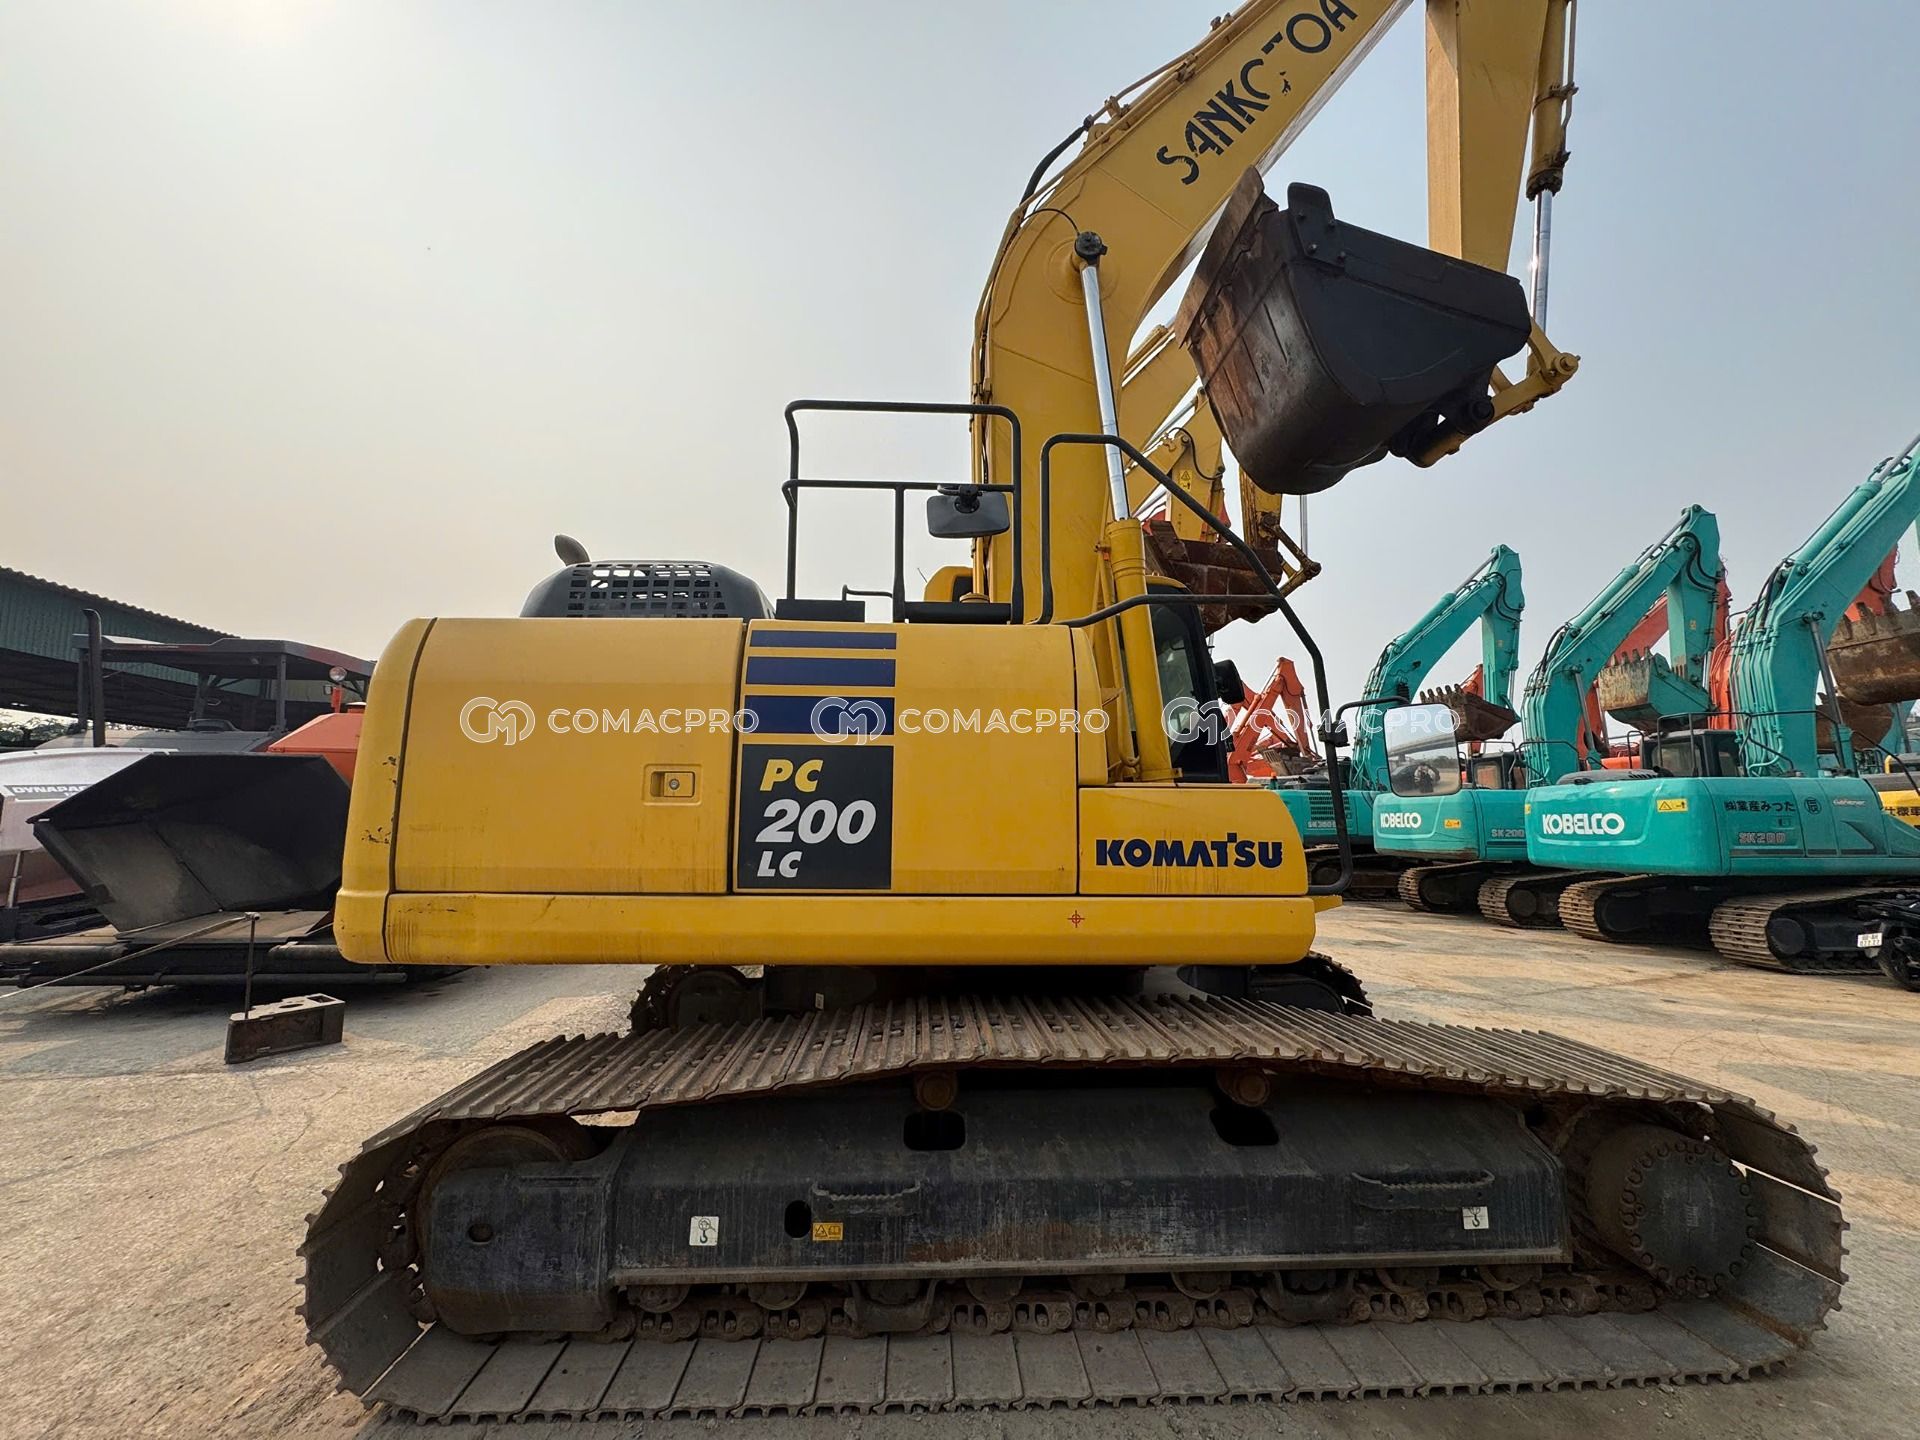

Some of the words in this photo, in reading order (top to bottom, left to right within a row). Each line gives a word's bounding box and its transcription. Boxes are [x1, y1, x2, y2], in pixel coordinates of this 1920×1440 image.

[760, 759, 823, 792] PC
[755, 798, 876, 844] 200
[1380, 812, 1422, 829] KOBELCO
[1542, 813, 1625, 835] KOBELCO
[757, 851, 803, 878] LC
[1096, 832, 1283, 868] KOMATSU
